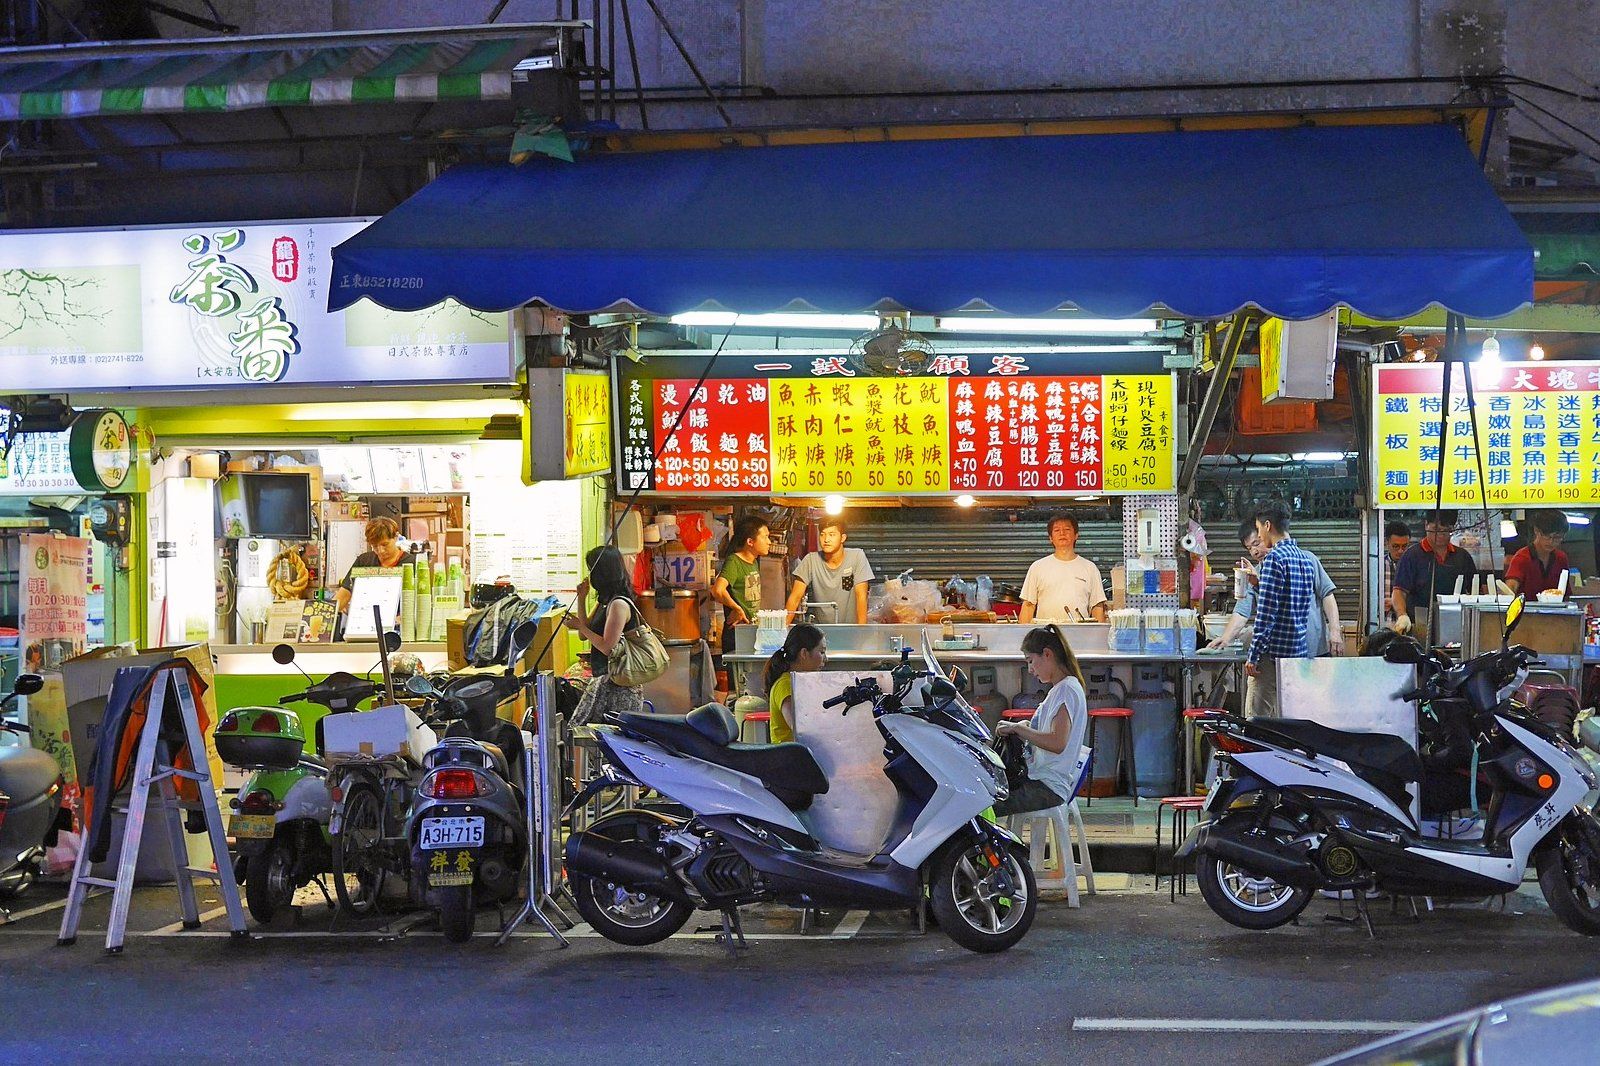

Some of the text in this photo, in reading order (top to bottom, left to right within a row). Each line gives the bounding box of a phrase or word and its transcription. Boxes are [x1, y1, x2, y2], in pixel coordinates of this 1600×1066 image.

[745, 382, 769, 454] 油飯
[954, 380, 977, 453] 麻辣鴨血
[983, 379, 1006, 468] 麻辣豆腐
[1018, 380, 1041, 467] 麻辣腸旺
[1384, 396, 1410, 486] 鐵板麵
[1487, 395, 1512, 485] 香嫩雞腿排
[1522, 394, 1547, 484] 冰島鱈魚排
[1557, 394, 1581, 484] 迷迭香羊排
[781, 471, 797, 487] 50
[808, 470, 825, 487] 50
[836, 470, 853, 487] 50
[868, 470, 885, 487] 50
[897, 469, 914, 486] 50
[924, 469, 941, 486] 50
[986, 470, 1004, 488] 70
[1017, 470, 1040, 488] 120
[1046, 469, 1065, 488] 80
[1074, 469, 1098, 488] 150
[1384, 490, 1410, 501] 60
[1453, 489, 1475, 500] 140
[1487, 488, 1509, 499] 140
[1523, 487, 1545, 499] 170
[1559, 487, 1581, 499] 190
[670, 556, 696, 583] 12
